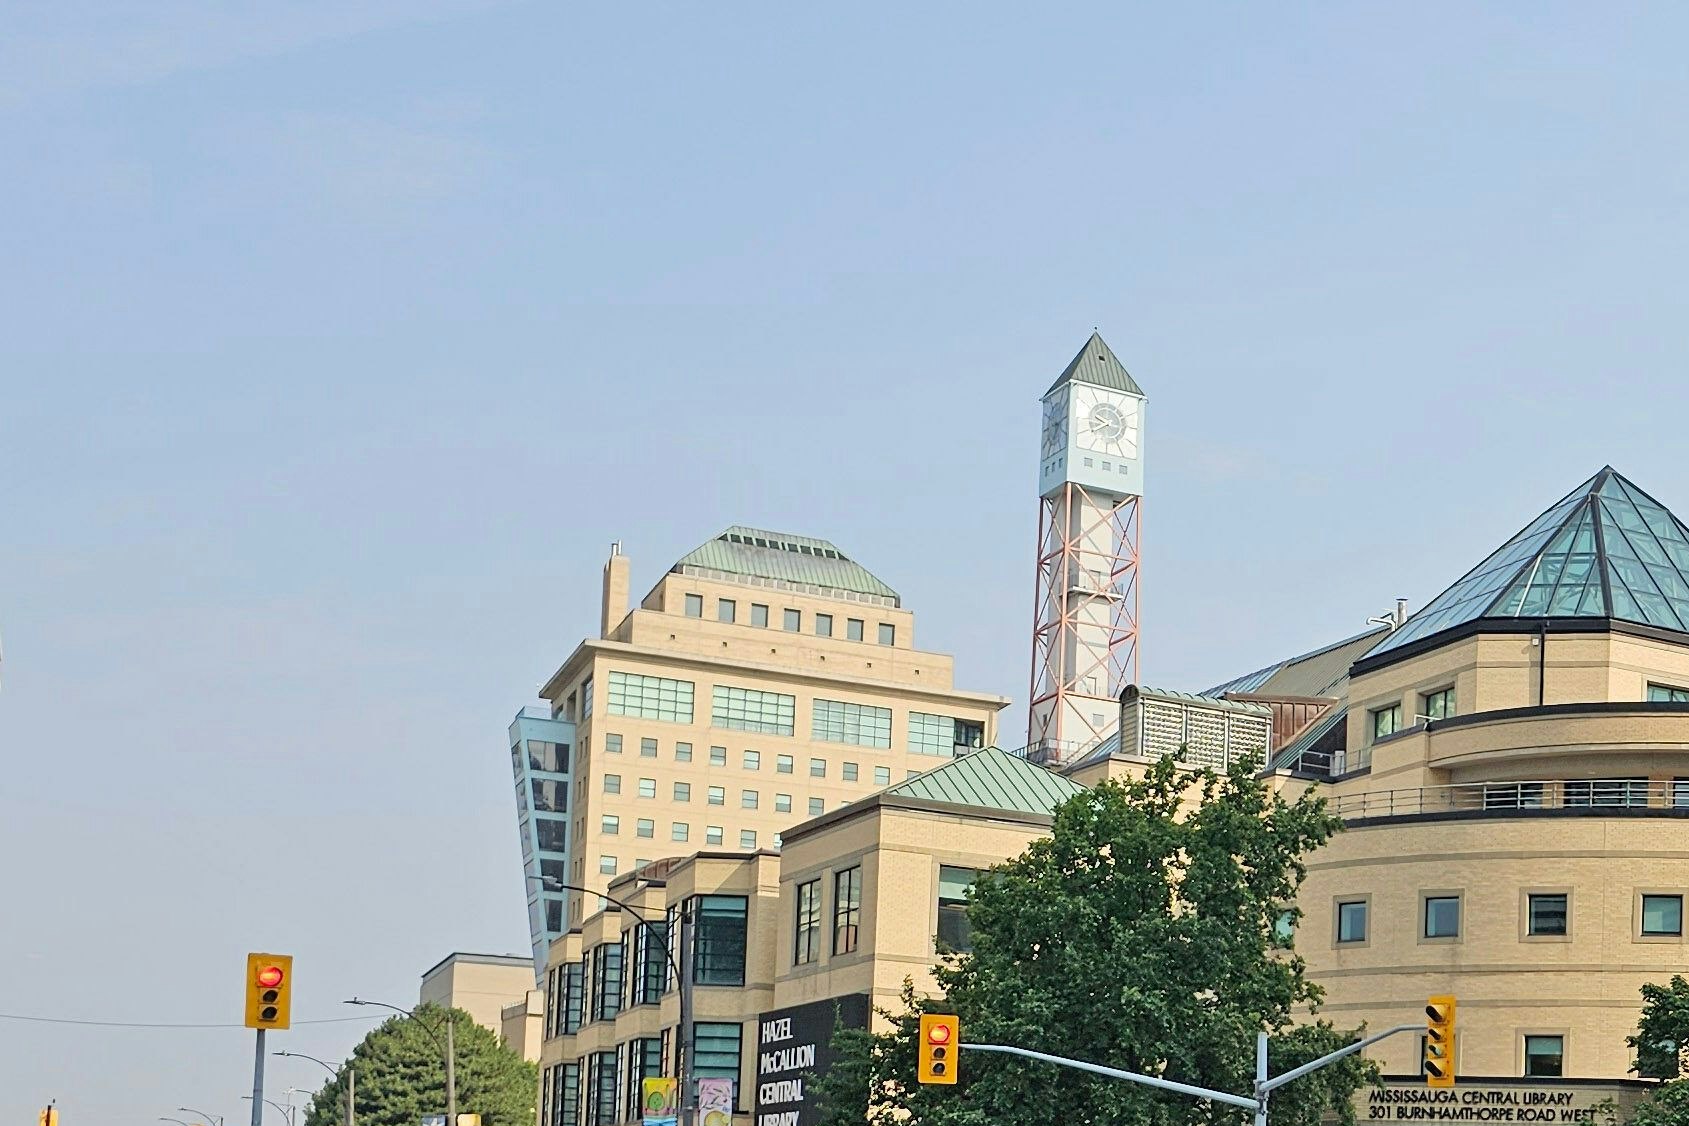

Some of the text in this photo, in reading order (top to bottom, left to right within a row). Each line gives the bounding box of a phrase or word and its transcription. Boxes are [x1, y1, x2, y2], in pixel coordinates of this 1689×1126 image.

[762, 1018, 793, 1044] HAZEL
[760, 1044, 815, 1074] McCALLION
[760, 1079, 803, 1105] CENTRAL
[1369, 1089, 1573, 1105] MISSISSAUGA CENTRAL LIBRARY
[1369, 1106, 1390, 1119] 301
[1397, 1106, 1513, 1120] BURNHAMTHORPE
[1517, 1108, 1556, 1121] ROAD
